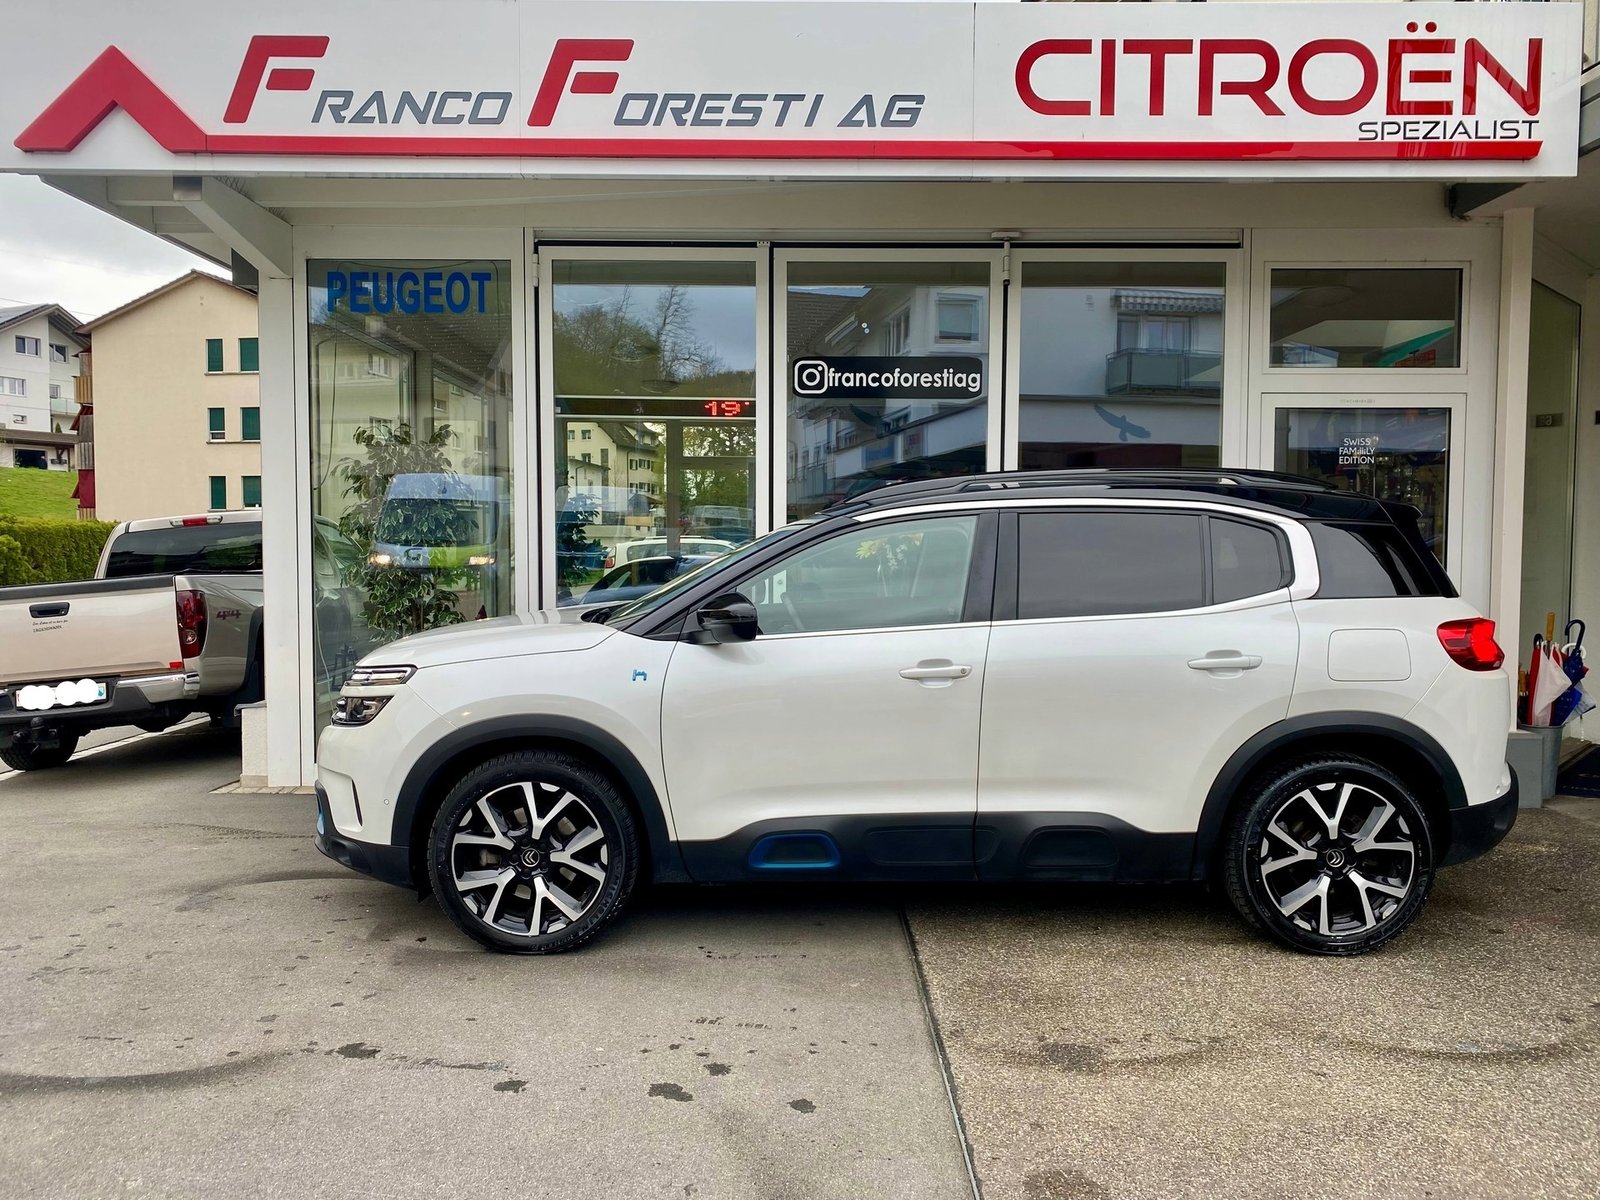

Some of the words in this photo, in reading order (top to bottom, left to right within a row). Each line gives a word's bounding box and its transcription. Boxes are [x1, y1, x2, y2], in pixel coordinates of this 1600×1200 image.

[223, 35, 513, 125] FRANCO
[527, 38, 825, 128] FORESTI
[837, 94, 926, 128] AG
[1015, 22, 1543, 117] CITROËN
[1358, 119, 1540, 141] SPEZIALIST
[327, 271, 492, 314] PEUGEOT
[828, 367, 981, 393] francoforestiag
[1343, 437, 1371, 446] SWISS
[1339, 456, 1375, 464] EDITION
